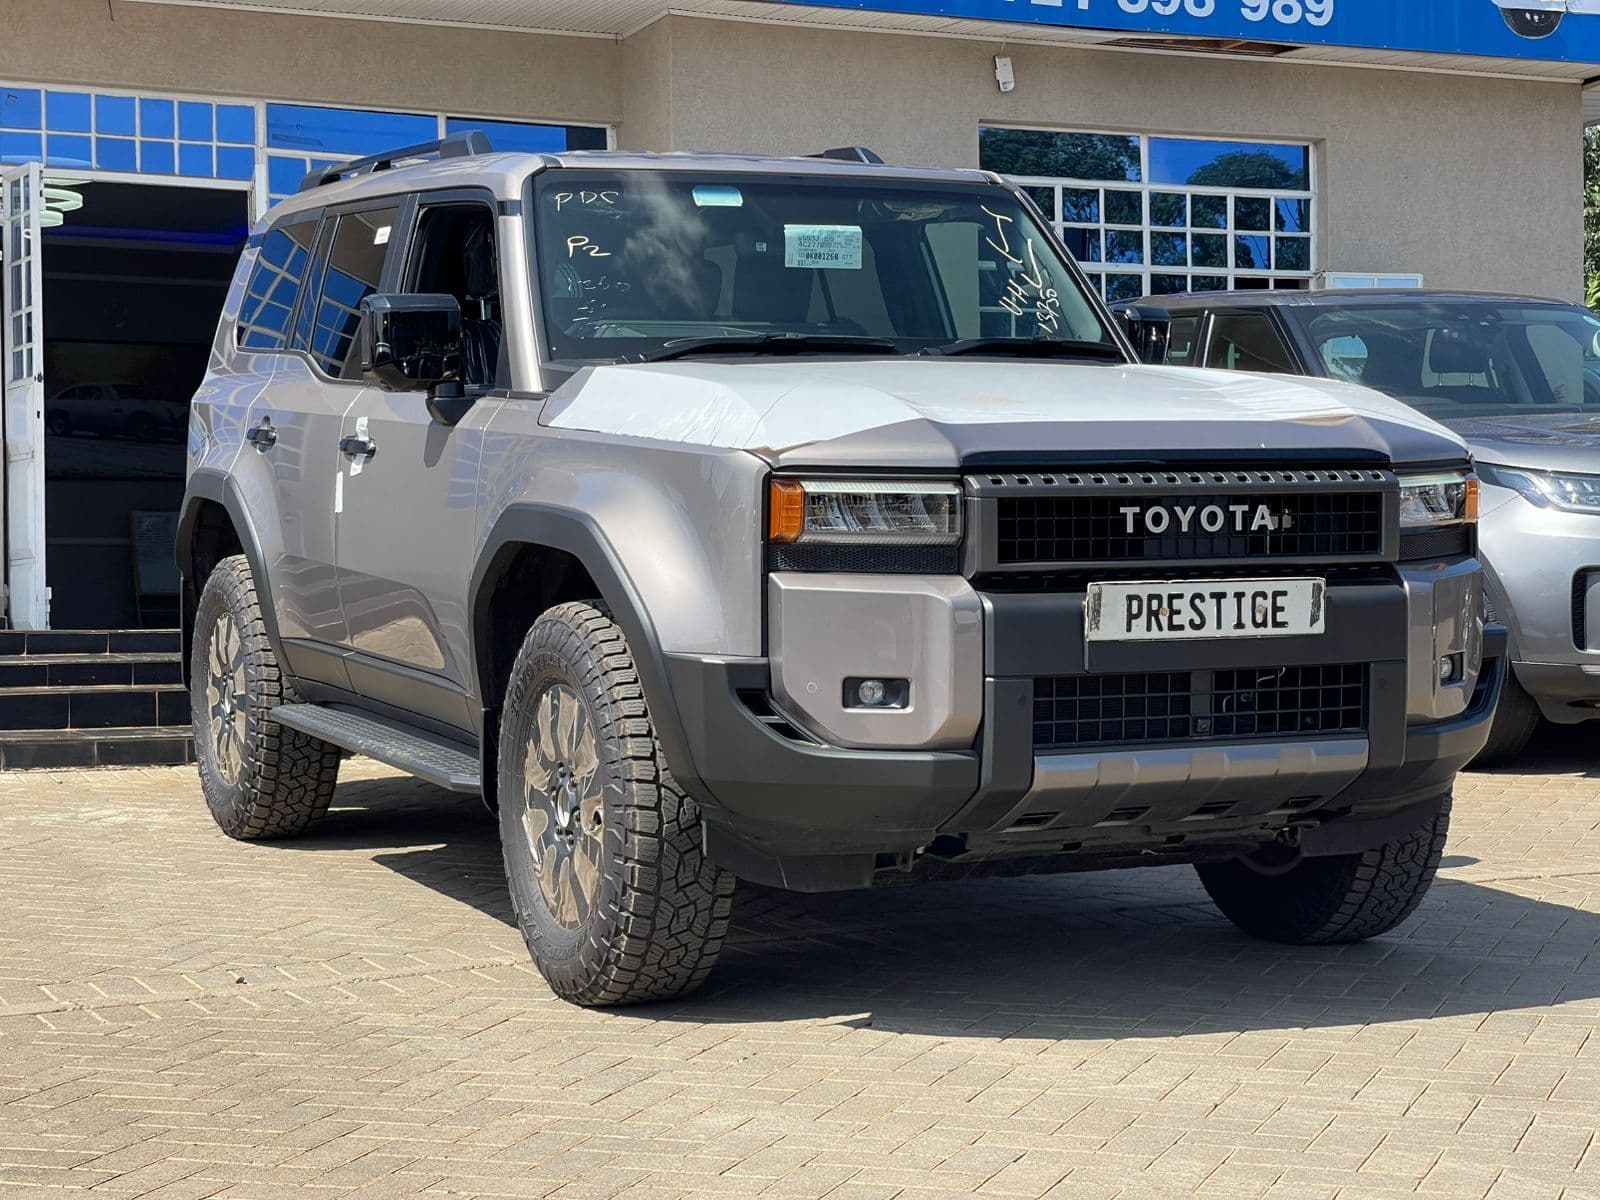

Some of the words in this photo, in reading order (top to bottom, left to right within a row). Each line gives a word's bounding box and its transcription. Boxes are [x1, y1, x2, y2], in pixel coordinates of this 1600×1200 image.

[567, 235, 612, 258] P2
[1119, 504, 1275, 534] TOYOTA
[1125, 590, 1289, 632] PRESTIGE
